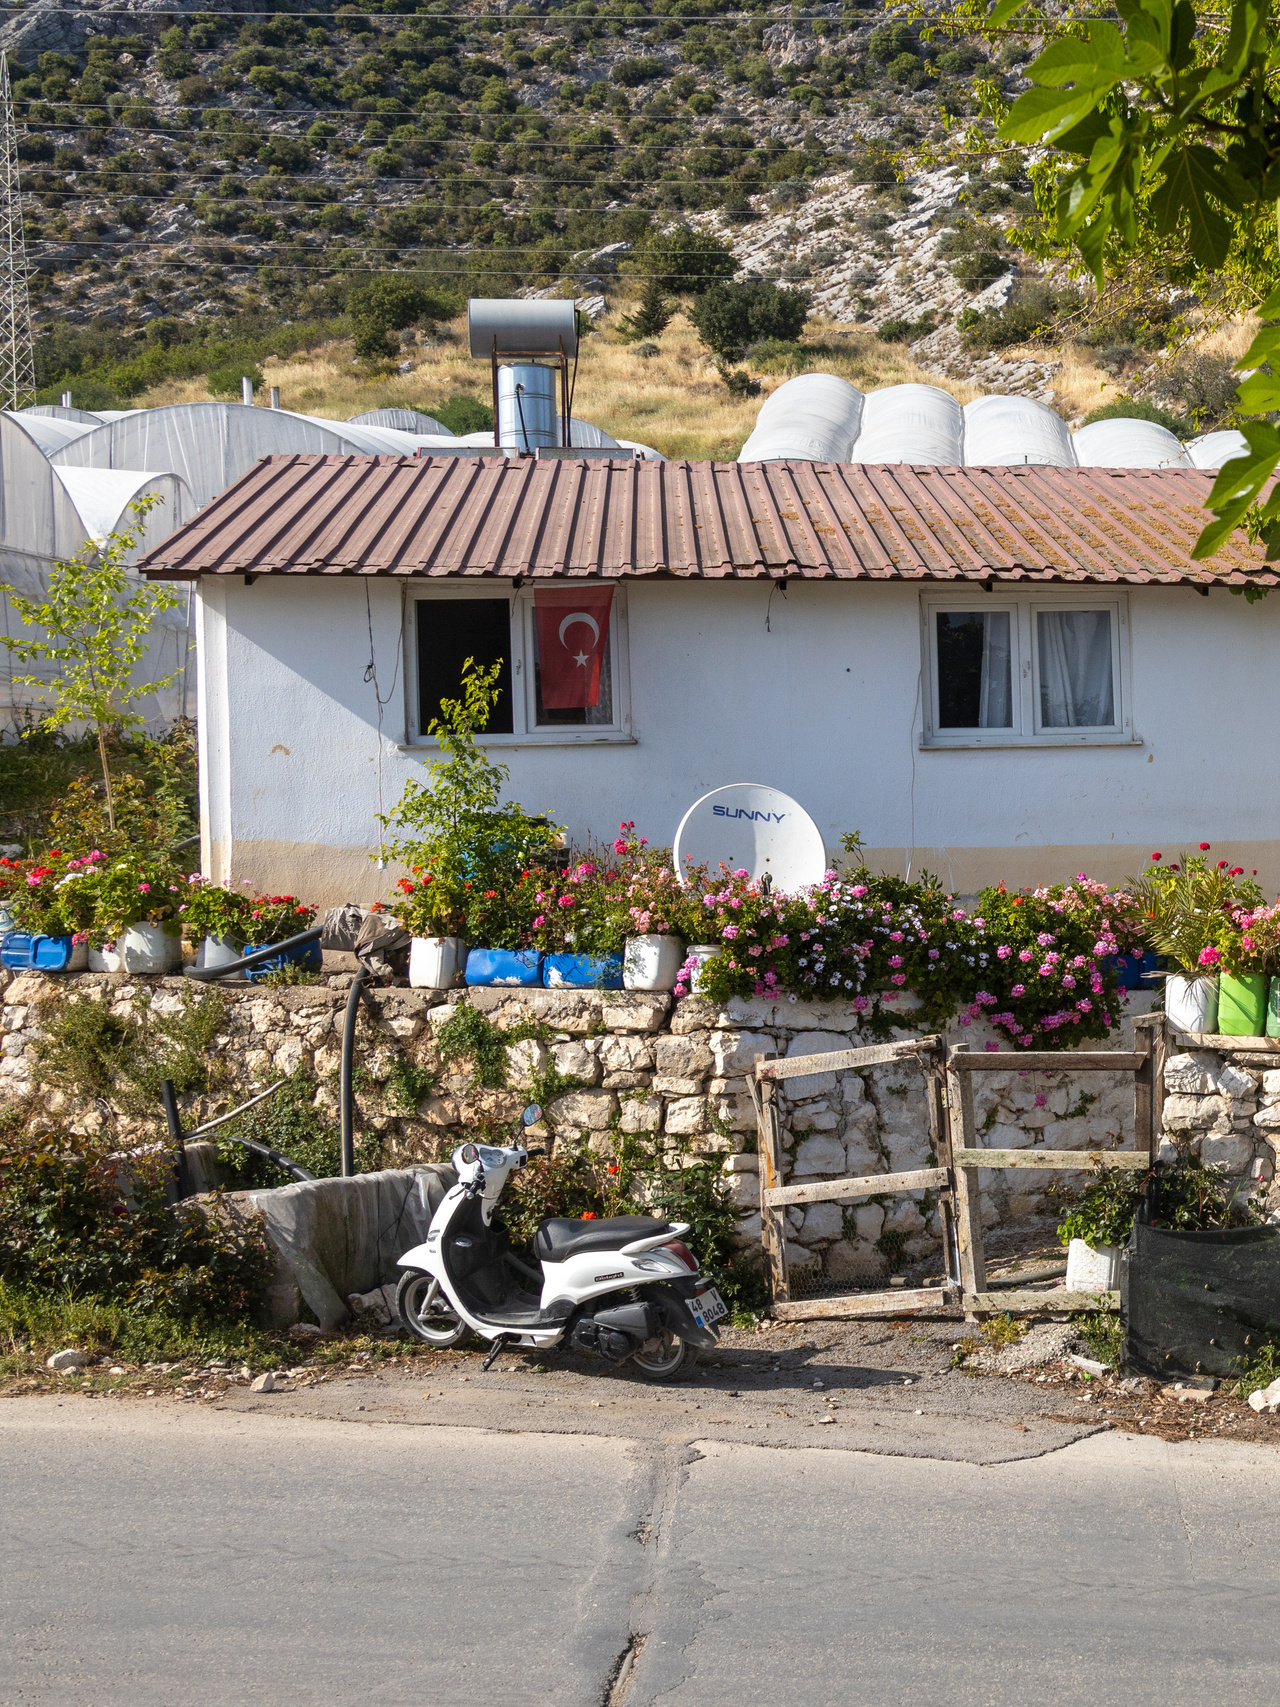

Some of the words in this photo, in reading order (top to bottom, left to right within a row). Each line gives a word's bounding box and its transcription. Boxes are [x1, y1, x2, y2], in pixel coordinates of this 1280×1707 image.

[712, 805, 786, 824] SUNNY
[691, 1298, 704, 1313] 48
[710, 1289, 718, 1302] V
[702, 1302, 726, 1323] 8048
